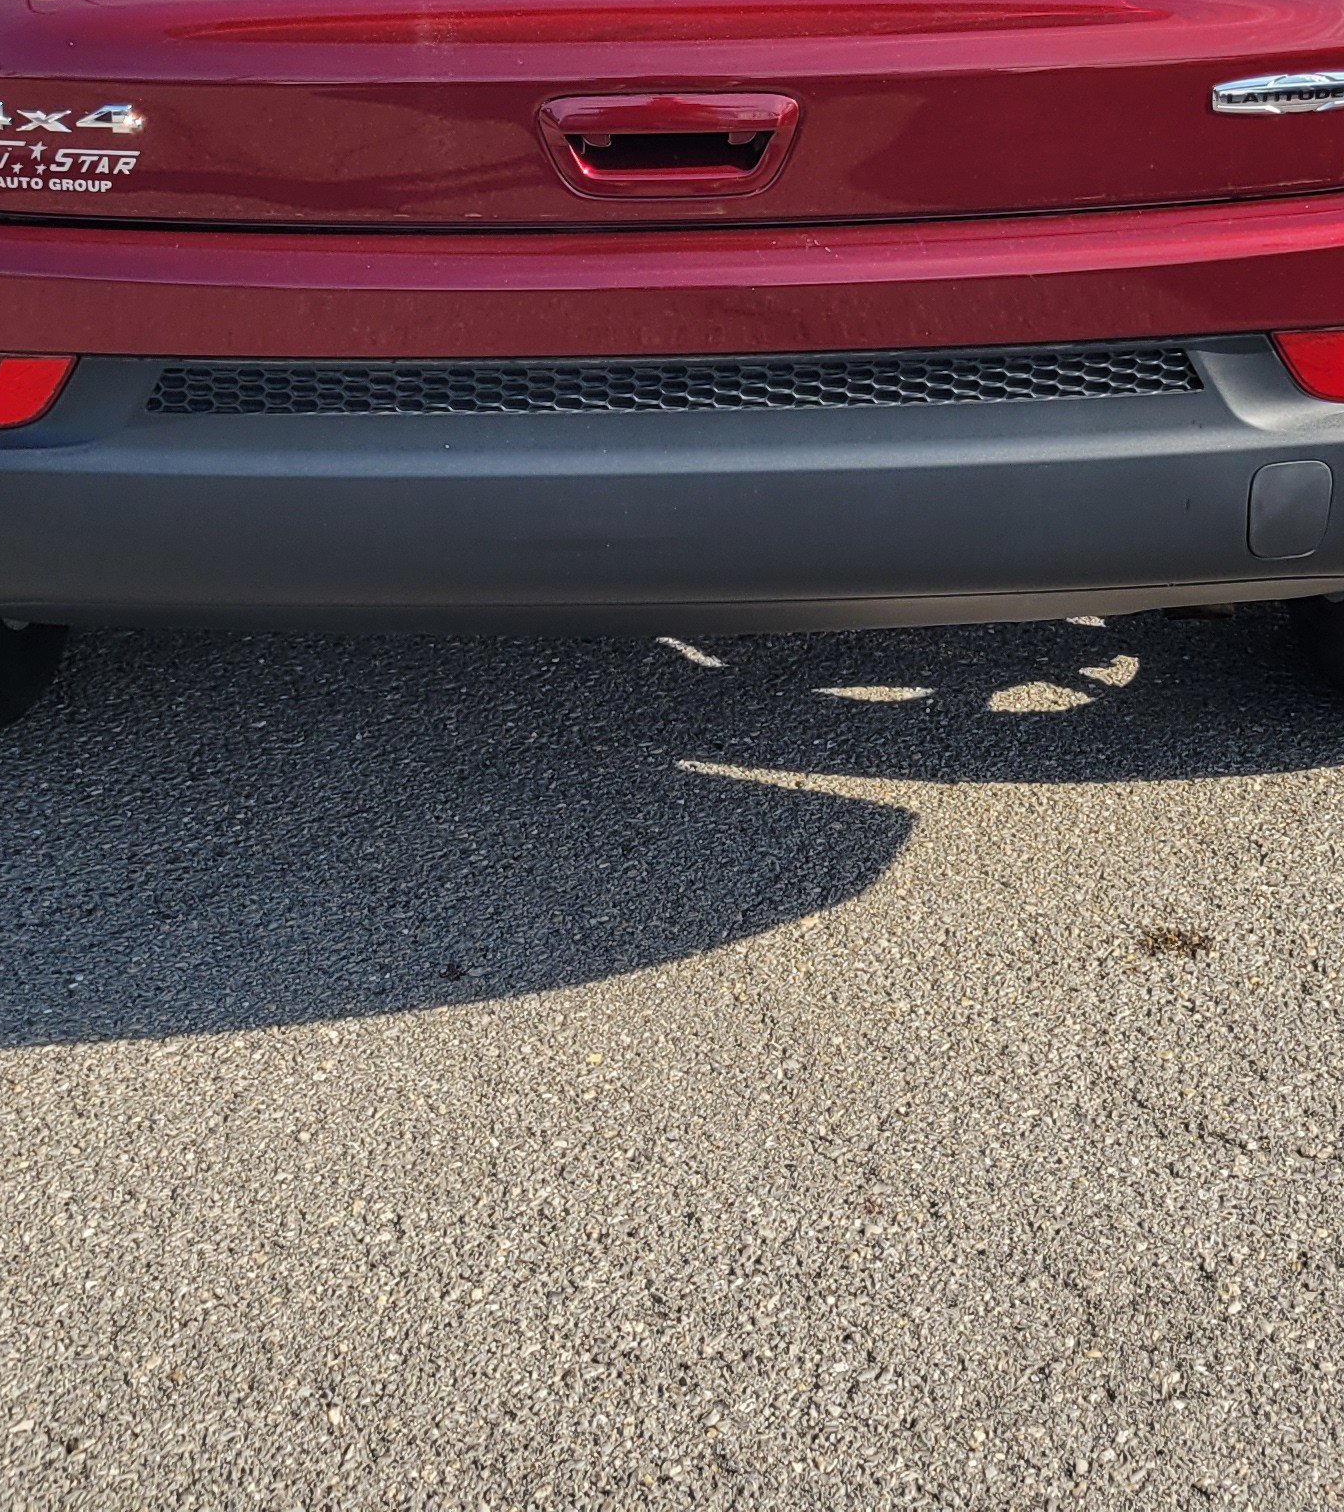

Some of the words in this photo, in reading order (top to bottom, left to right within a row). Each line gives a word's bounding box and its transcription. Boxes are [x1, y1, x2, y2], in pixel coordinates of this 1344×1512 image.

[1226, 87, 1344, 104] LATITUDE
[50, 148, 141, 175] STAR
[48, 178, 113, 193] GROUP
